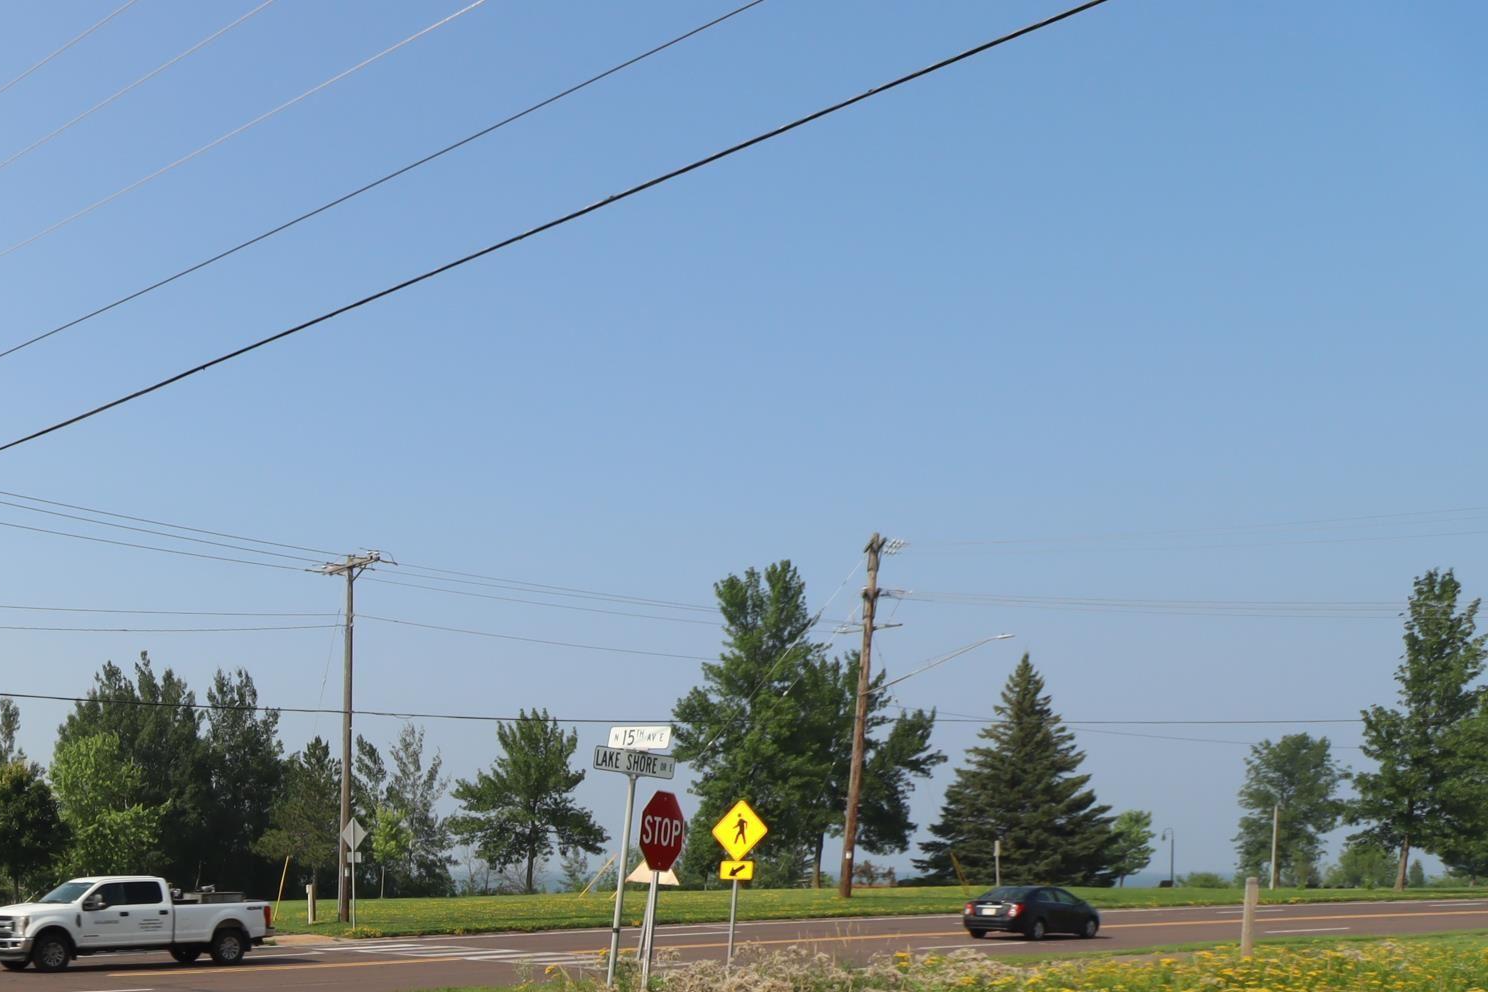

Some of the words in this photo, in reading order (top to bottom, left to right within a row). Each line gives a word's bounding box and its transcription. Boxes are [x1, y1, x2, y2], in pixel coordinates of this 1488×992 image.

[614, 733, 620, 742] N
[647, 734, 656, 742] AV
[660, 733, 664, 743] E
[596, 749, 621, 769] LAKE
[626, 753, 658, 774] SHORE
[642, 815, 681, 847] STOP
